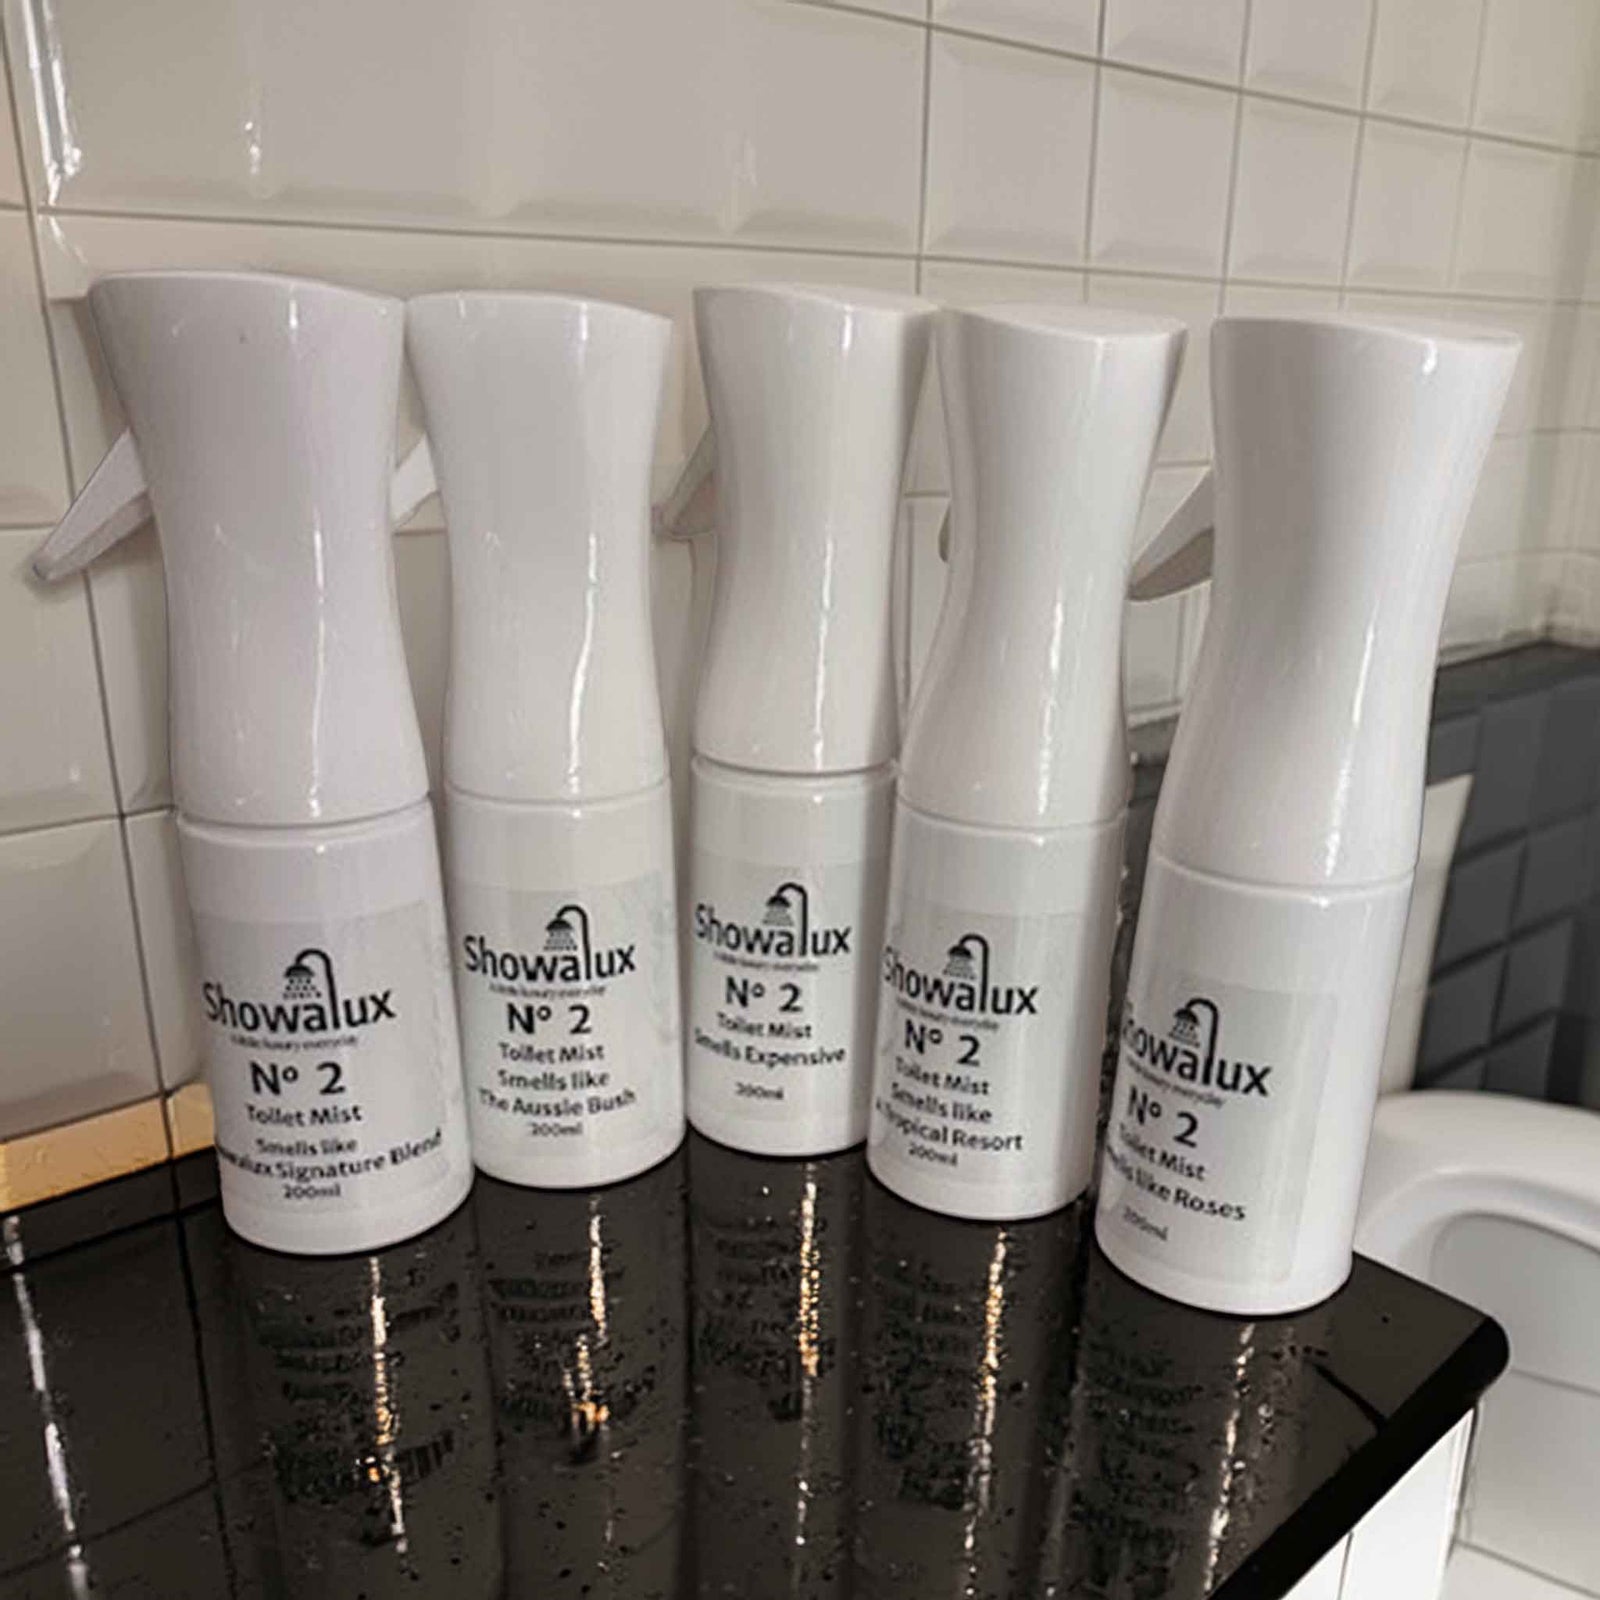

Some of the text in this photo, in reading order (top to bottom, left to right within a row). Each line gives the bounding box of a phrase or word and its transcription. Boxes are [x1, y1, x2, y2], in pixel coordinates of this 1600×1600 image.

[695, 882, 851, 957] Showalux
[464, 904, 636, 982] Showalux
[203, 949, 396, 1033] Showalux
[779, 982, 803, 1012] 2
[569, 1005, 592, 1034] 2
[717, 1011, 812, 1038] Toilet Mist
[499, 1042, 604, 1064] Toilet Mist
[745, 1047, 846, 1069] Expensive
[957, 1034, 980, 1067] 2
[317, 1062, 345, 1095] 2
[498, 1069, 610, 1091] Smells like
[896, 1057, 990, 1095] Toilet Mist
[479, 1088, 636, 1116] The Aussie Bush
[736, 1082, 784, 1100] 200ml
[892, 1082, 992, 1123] Smells like
[245, 1102, 362, 1127] Toilet Mist
[531, 1123, 582, 1136] 200ml
[952, 1129, 1023, 1151] Resort
[1173, 1111, 1198, 1148] 2
[256, 1138, 356, 1156] Smells like
[276, 1156, 385, 1183] Signature
[390, 1126, 442, 1164] Blend
[908, 1143, 958, 1166] 200ml
[1159, 1150, 1206, 1181] Mist
[283, 1184, 341, 1200] 200ml
[1136, 1168, 1171, 1201] like
[1175, 1188, 1246, 1221] Roses
